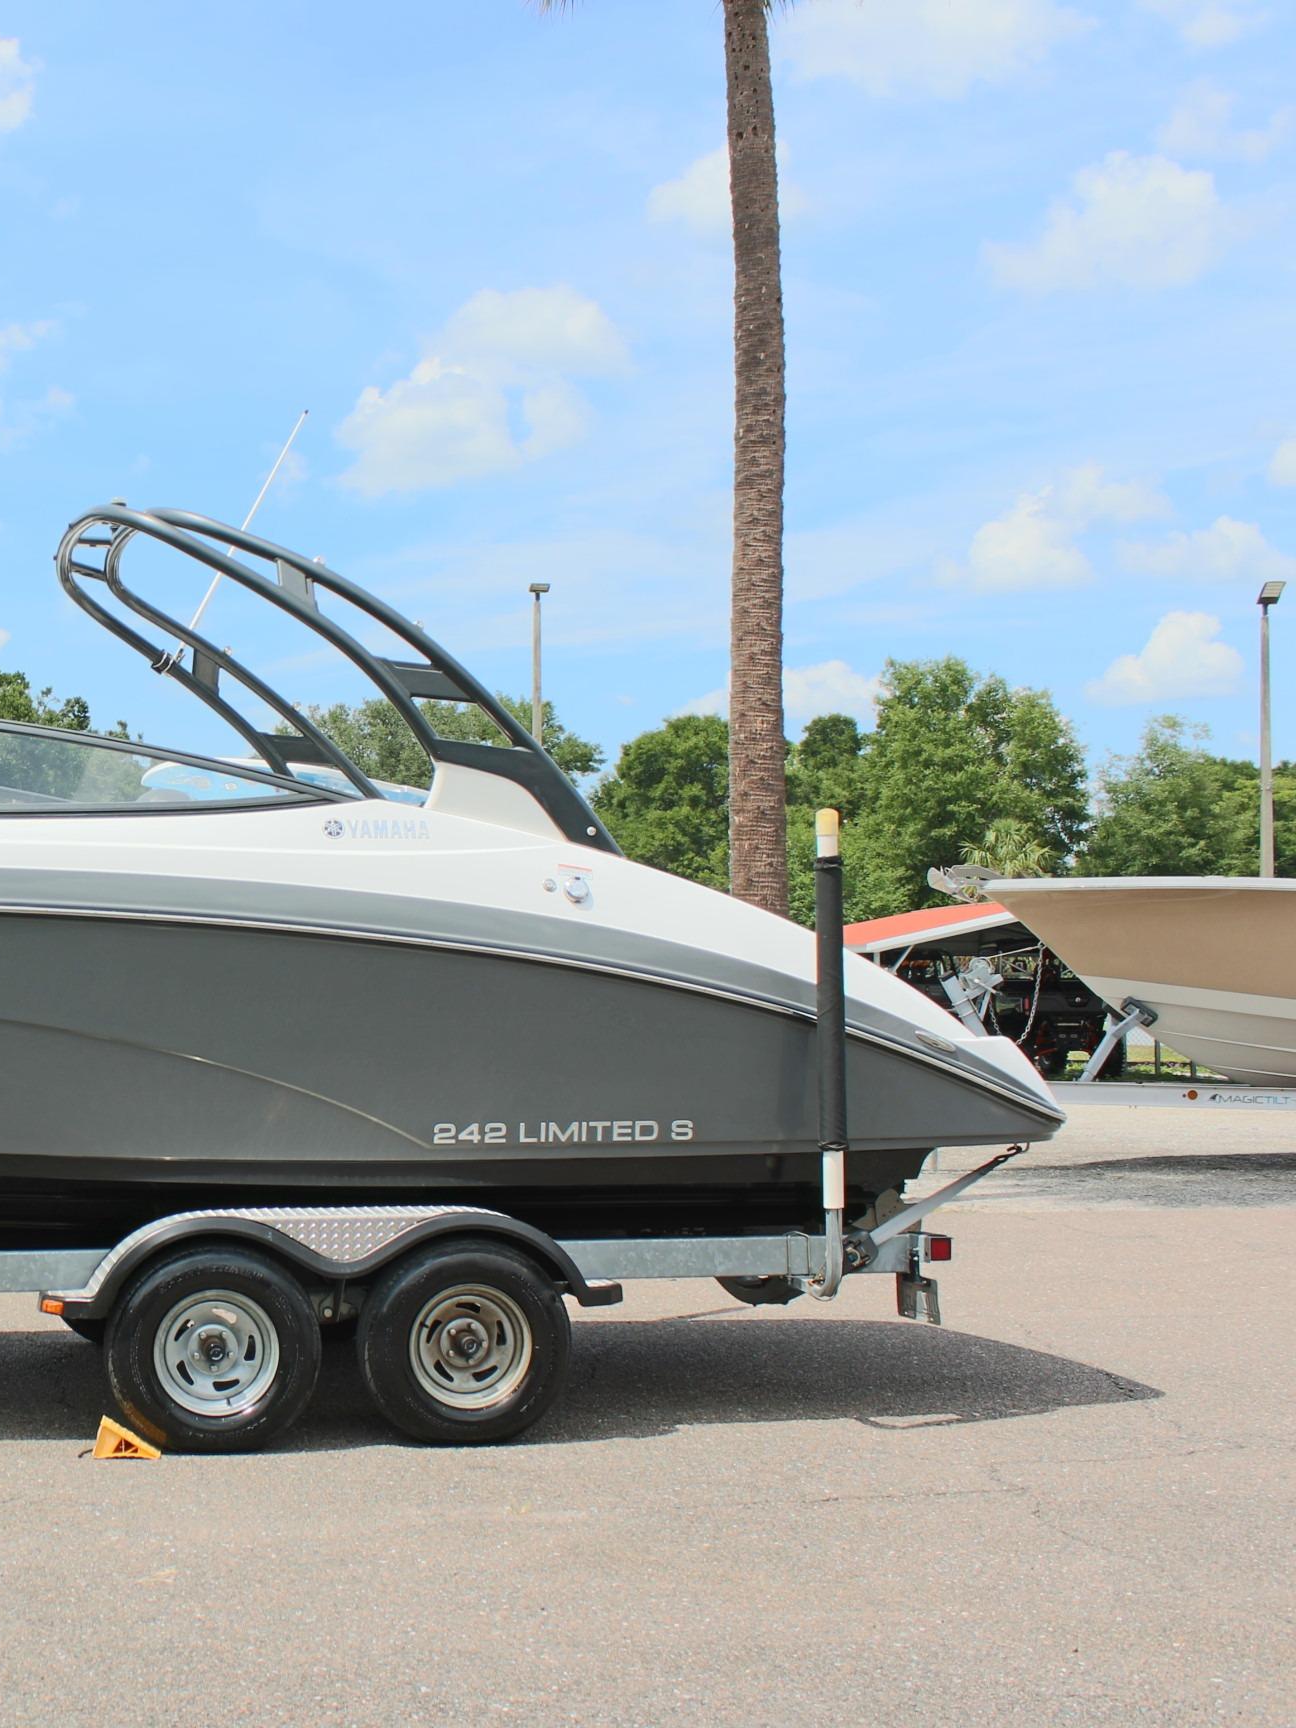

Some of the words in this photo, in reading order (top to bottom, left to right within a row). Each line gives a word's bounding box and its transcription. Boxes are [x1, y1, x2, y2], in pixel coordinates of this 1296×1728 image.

[347, 819, 431, 839] YAMAHA
[433, 1122, 507, 1144] 242
[519, 1121, 659, 1143] LIMITED
[671, 1120, 694, 1141] S
